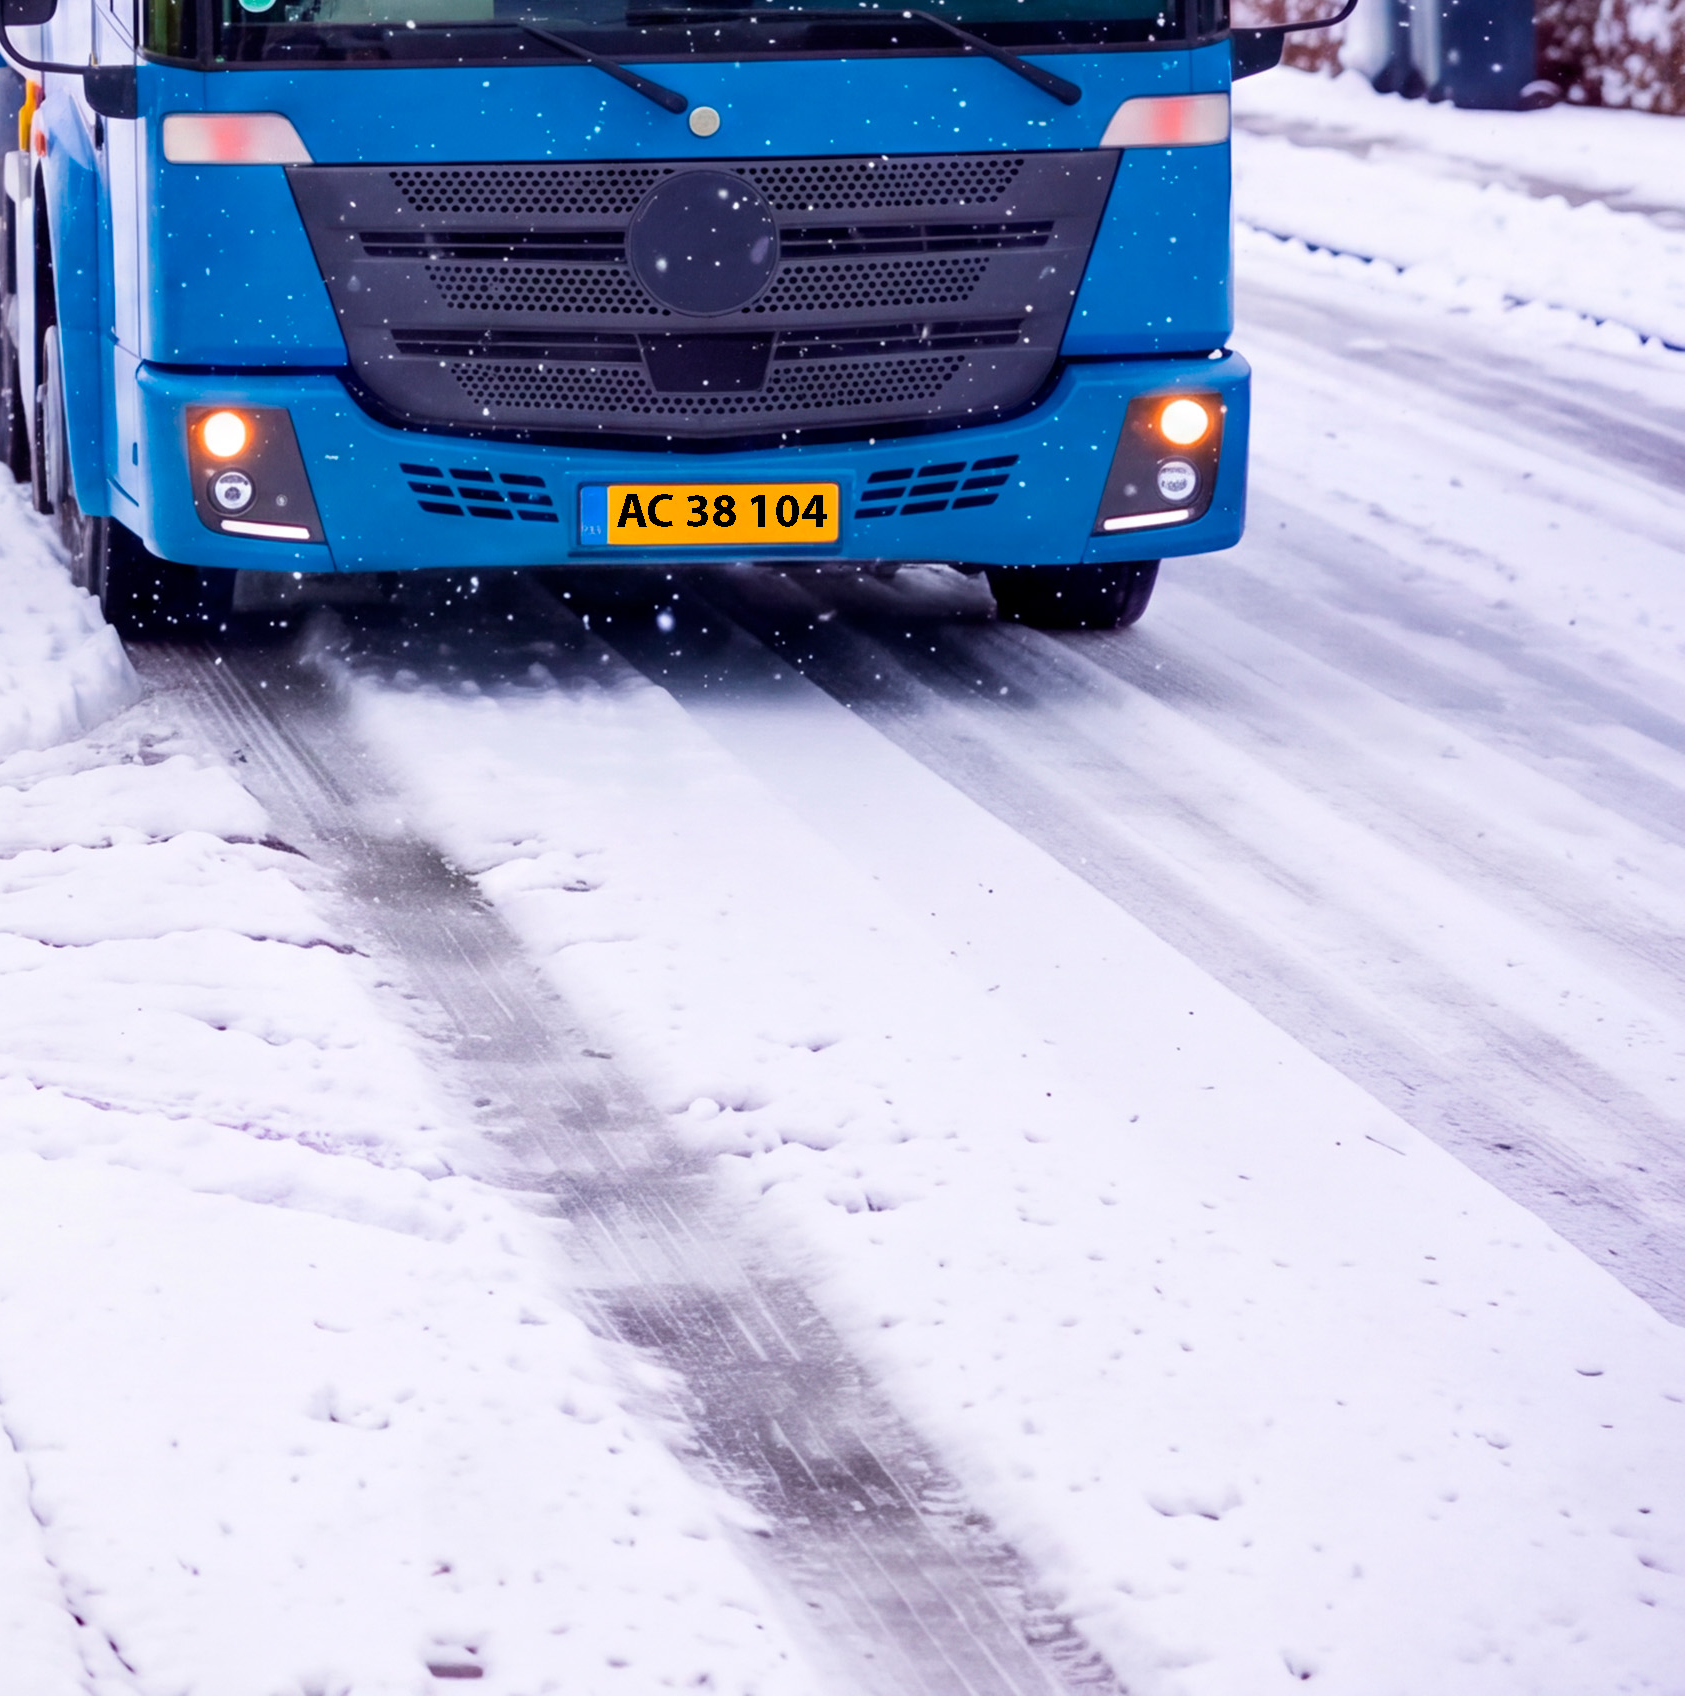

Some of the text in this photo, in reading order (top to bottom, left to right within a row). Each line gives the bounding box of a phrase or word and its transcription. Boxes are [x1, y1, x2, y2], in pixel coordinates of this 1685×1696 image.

[616, 493, 828, 528] AC 38 104
